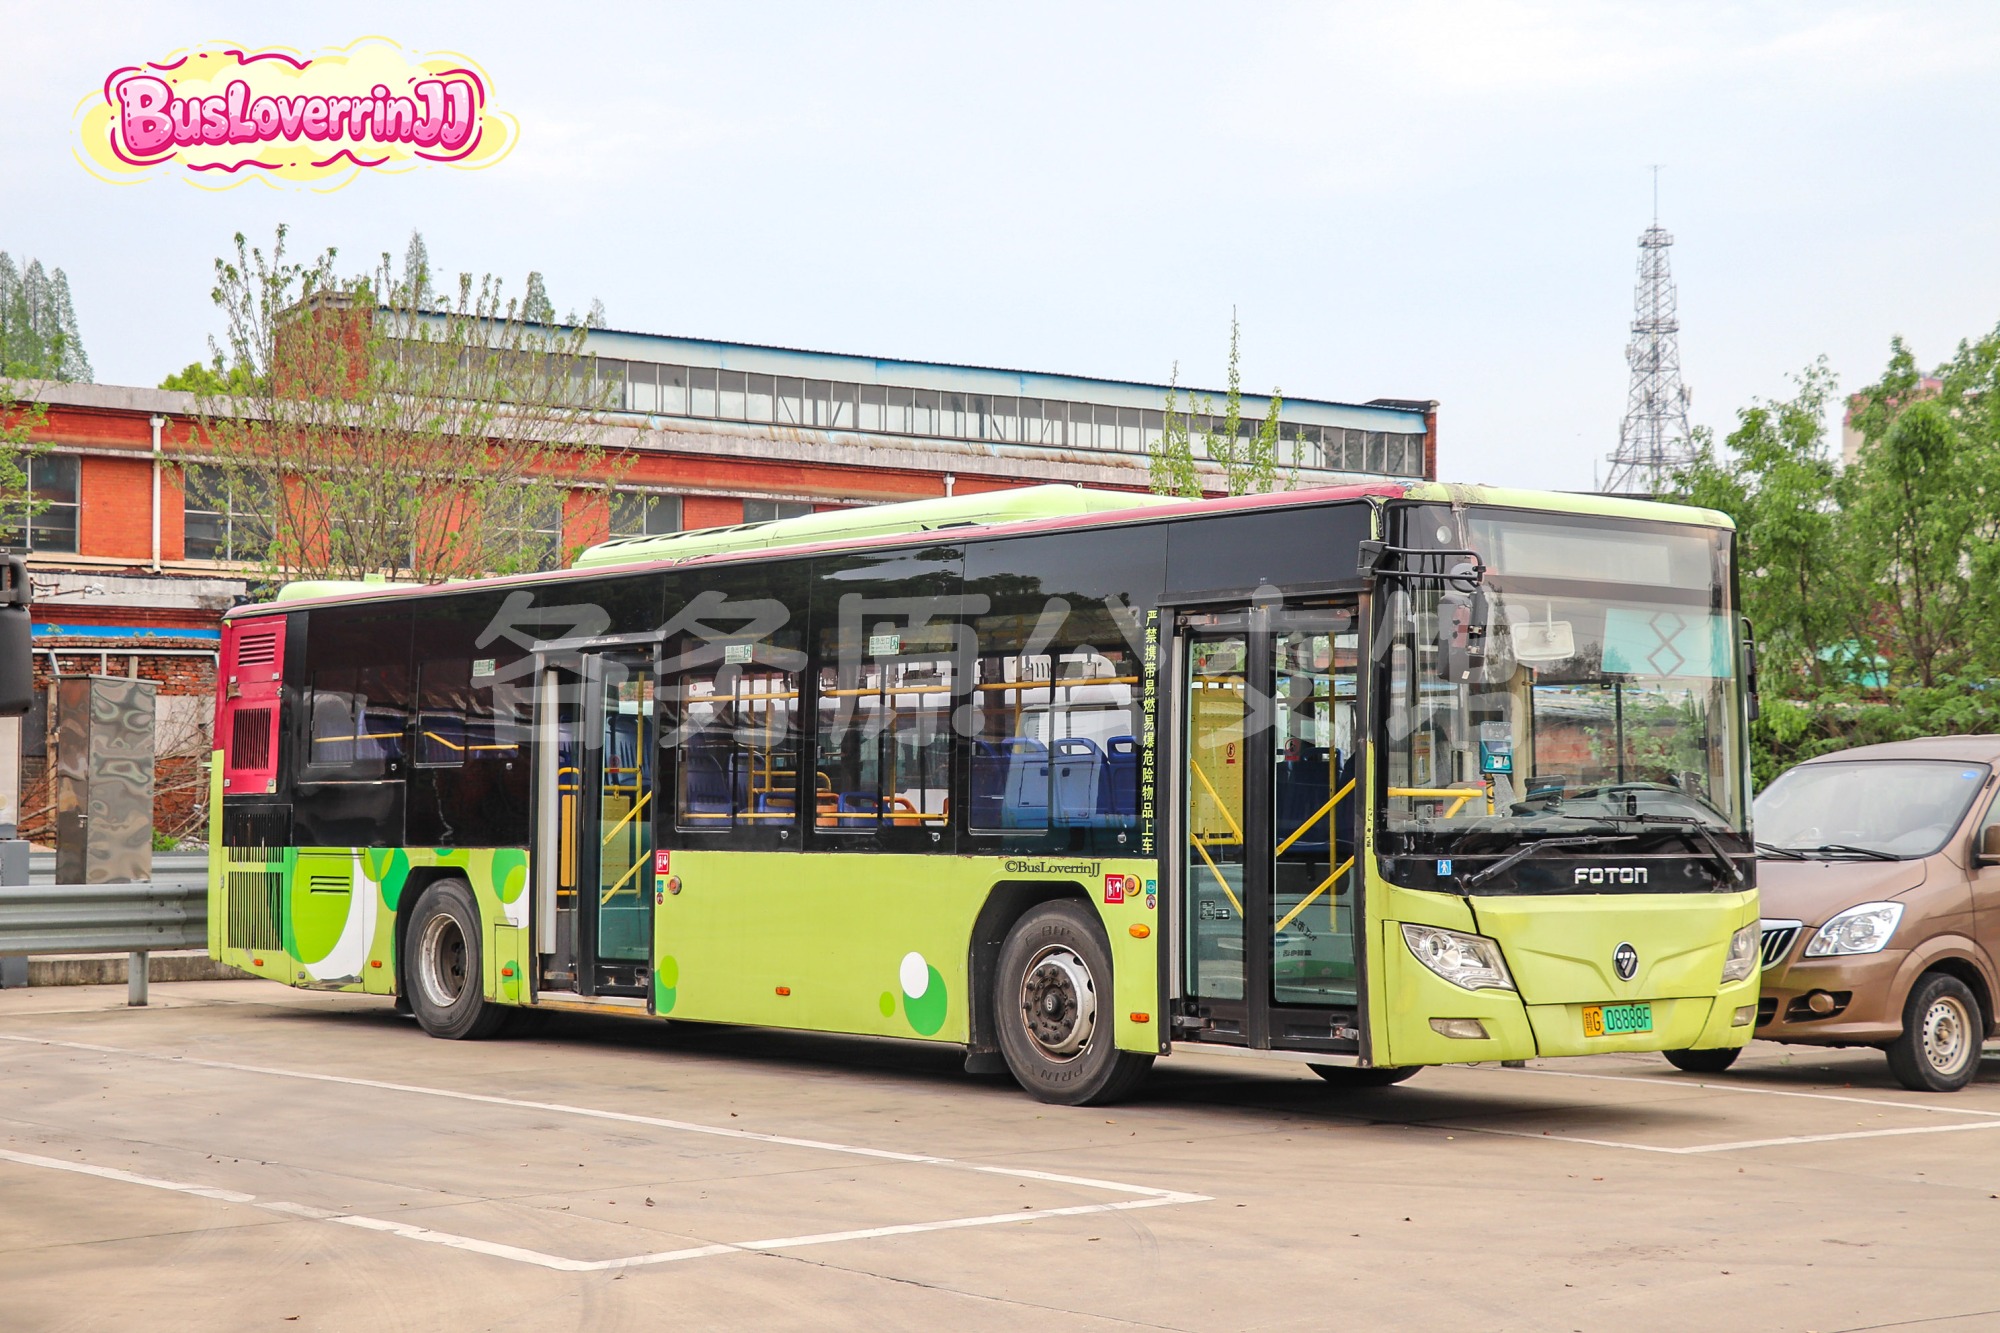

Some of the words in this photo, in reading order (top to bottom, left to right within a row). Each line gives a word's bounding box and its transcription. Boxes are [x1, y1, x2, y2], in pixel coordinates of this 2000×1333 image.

[1141, 610, 1158, 855] 严禁携带易燃易爆危险物品上车
[1574, 867, 1648, 885] FOTON
